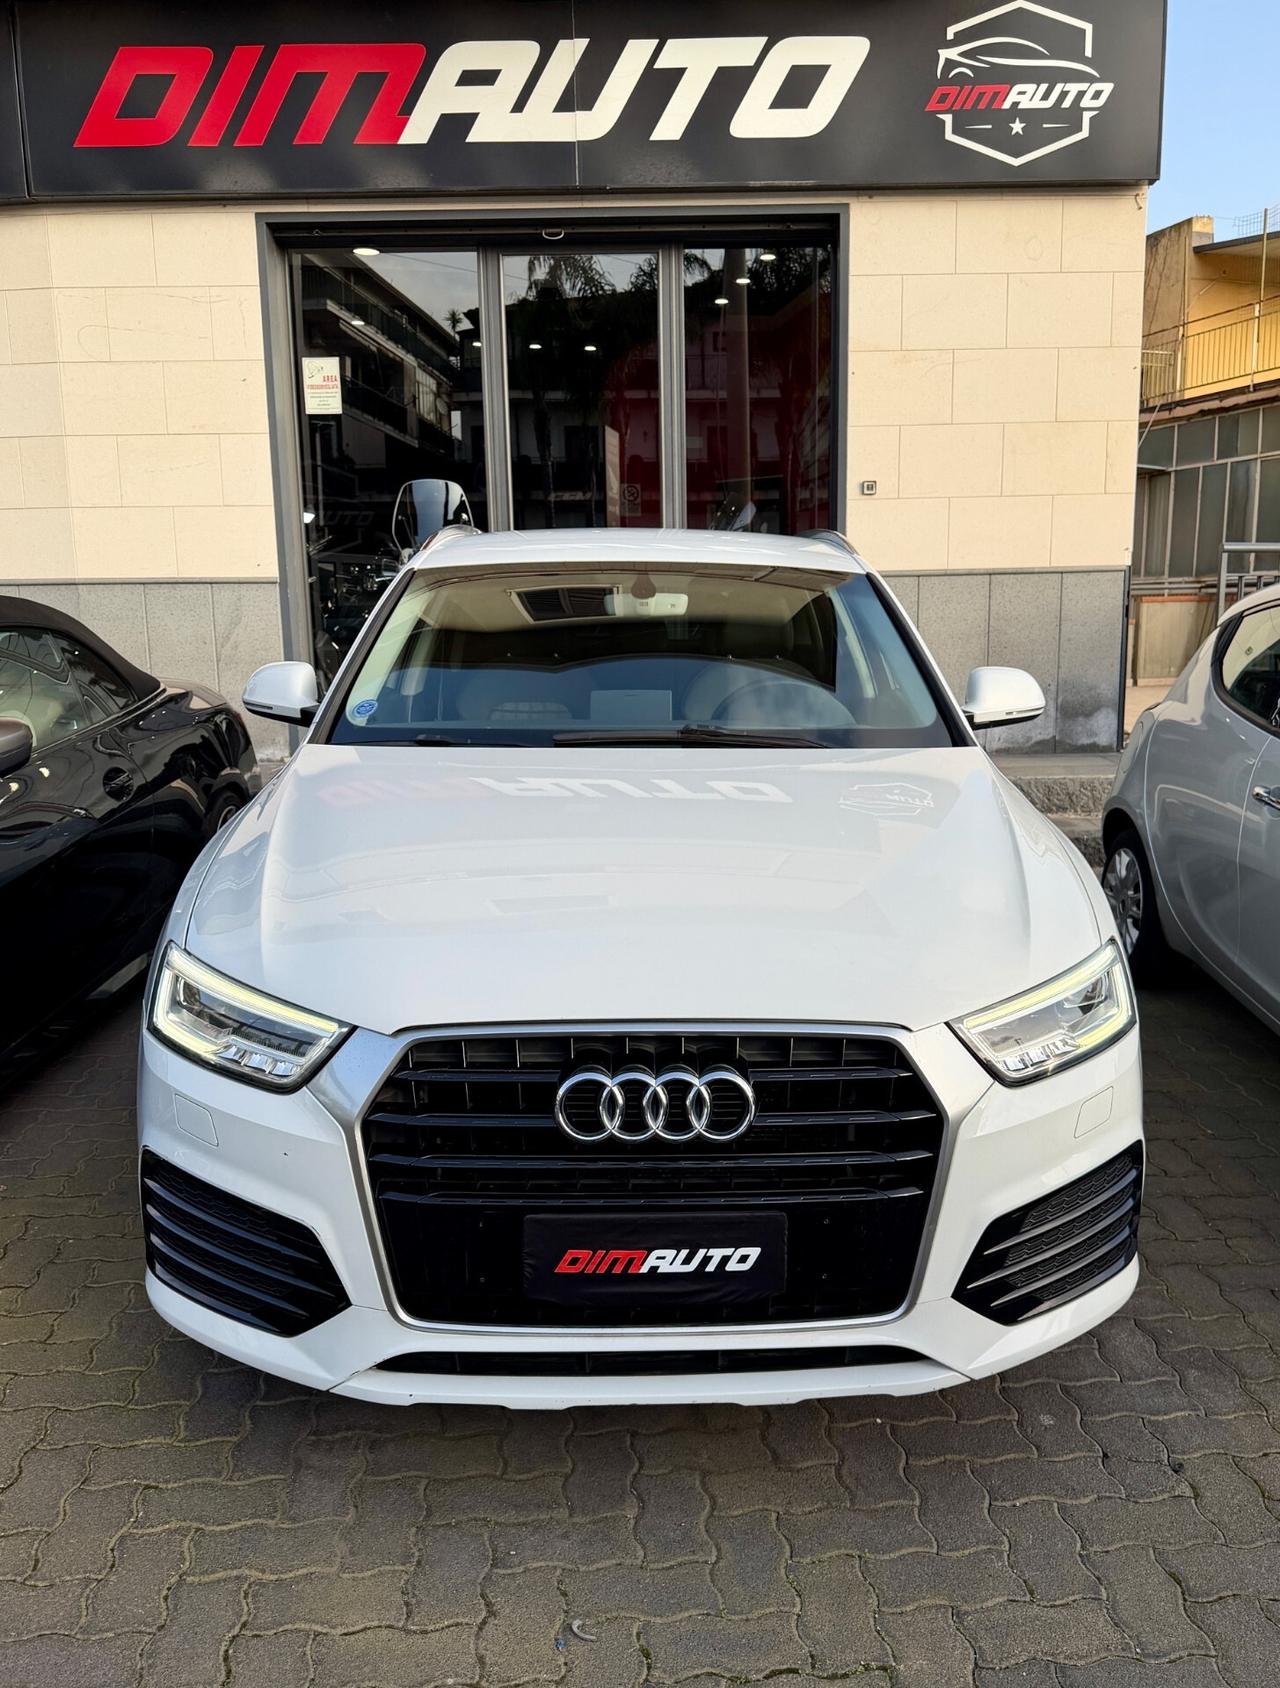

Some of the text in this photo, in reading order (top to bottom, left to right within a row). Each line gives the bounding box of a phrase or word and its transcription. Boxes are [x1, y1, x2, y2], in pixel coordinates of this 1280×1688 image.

[74, 36, 870, 148] DIMAUTO
[925, 82, 1114, 111] DIMAUTO
[554, 1247, 762, 1274] DIMAUTO
